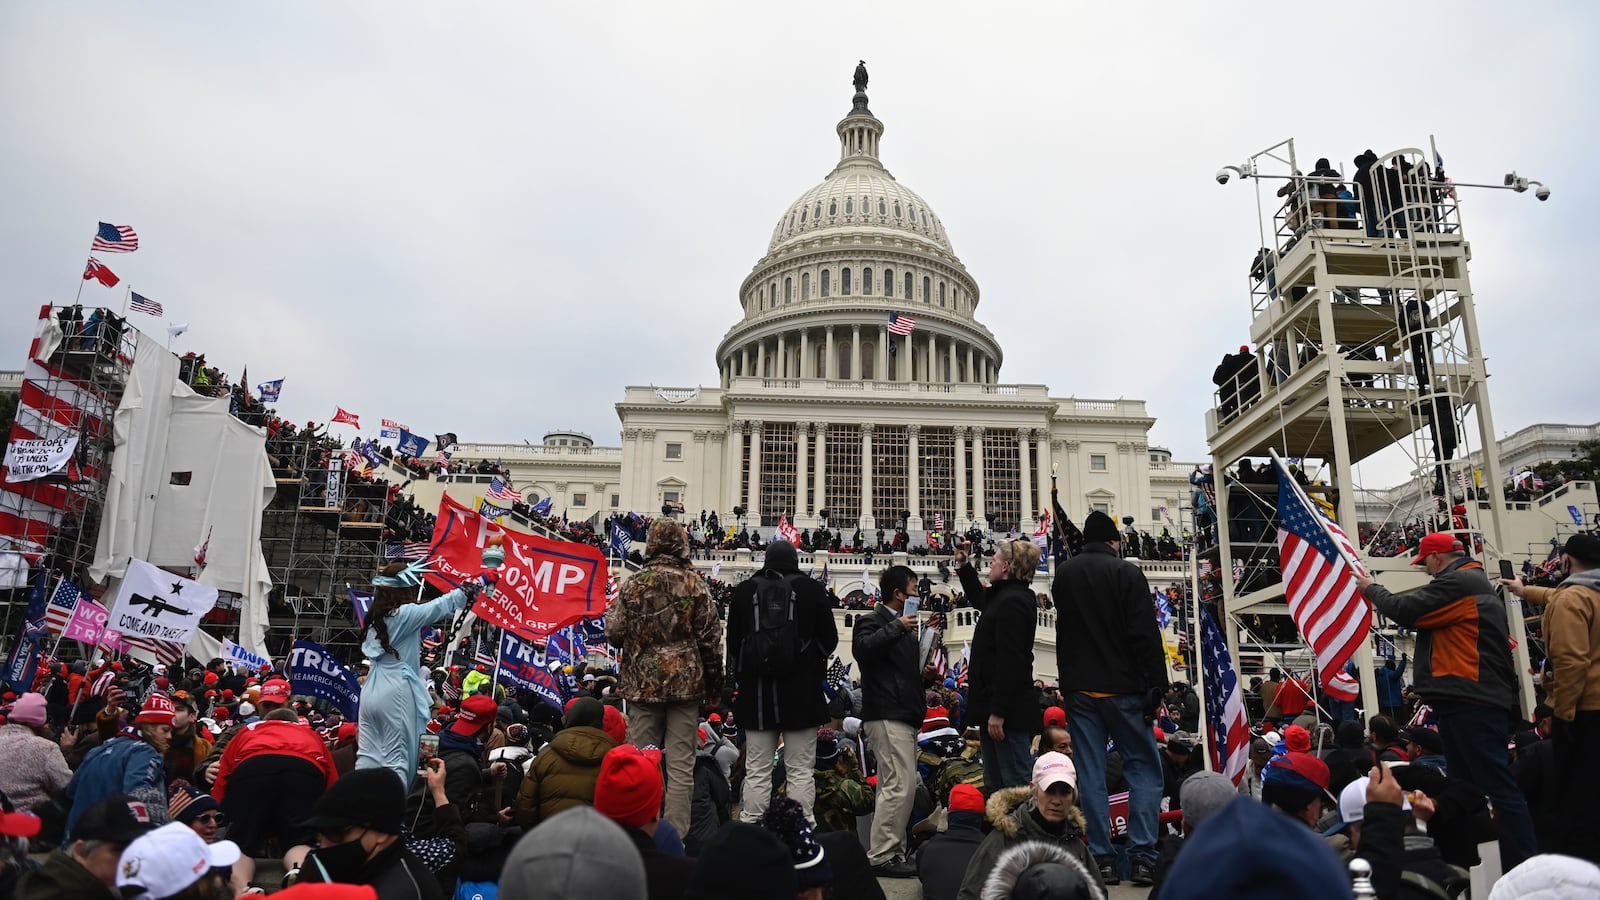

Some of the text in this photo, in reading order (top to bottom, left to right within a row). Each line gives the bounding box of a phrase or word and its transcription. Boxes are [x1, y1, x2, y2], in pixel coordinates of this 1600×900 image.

[448, 504, 585, 595] TRMP
[119, 613, 142, 633] COME
[139, 620, 161, 636] AND
[302, 673, 333, 687] AMERICA
[333, 681, 351, 698] GREAT
[499, 668, 512, 679] NO
[518, 663, 553, 688] 2020
